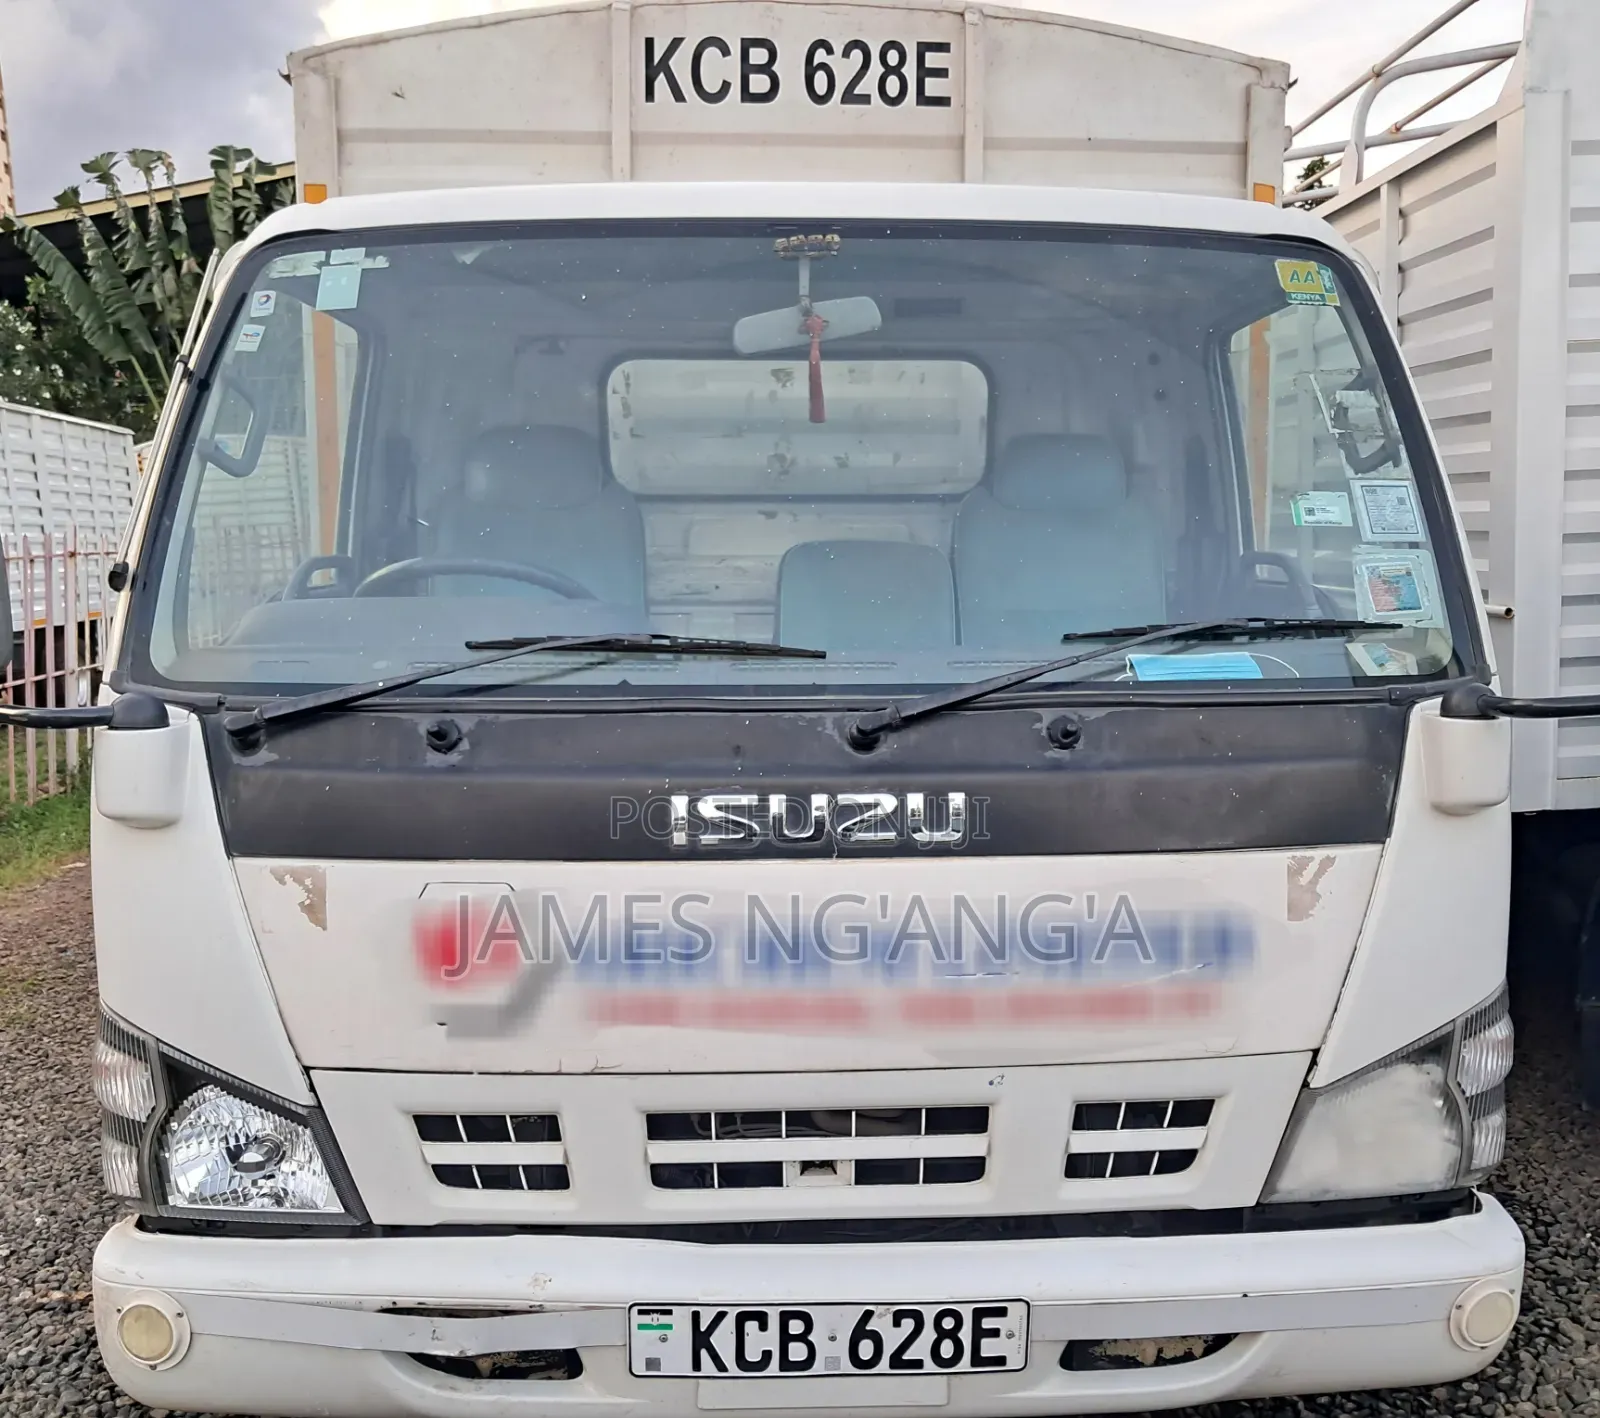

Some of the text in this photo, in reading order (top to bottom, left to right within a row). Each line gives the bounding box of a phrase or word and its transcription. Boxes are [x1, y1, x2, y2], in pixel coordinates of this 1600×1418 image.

[644, 36, 952, 107] KCB 628E
[1289, 269, 1316, 284] AA
[1290, 293, 1322, 301] KENYA
[670, 792, 967, 847] ISUZU
[691, 1310, 816, 1373] KCB
[848, 1306, 1009, 1371] 628E
